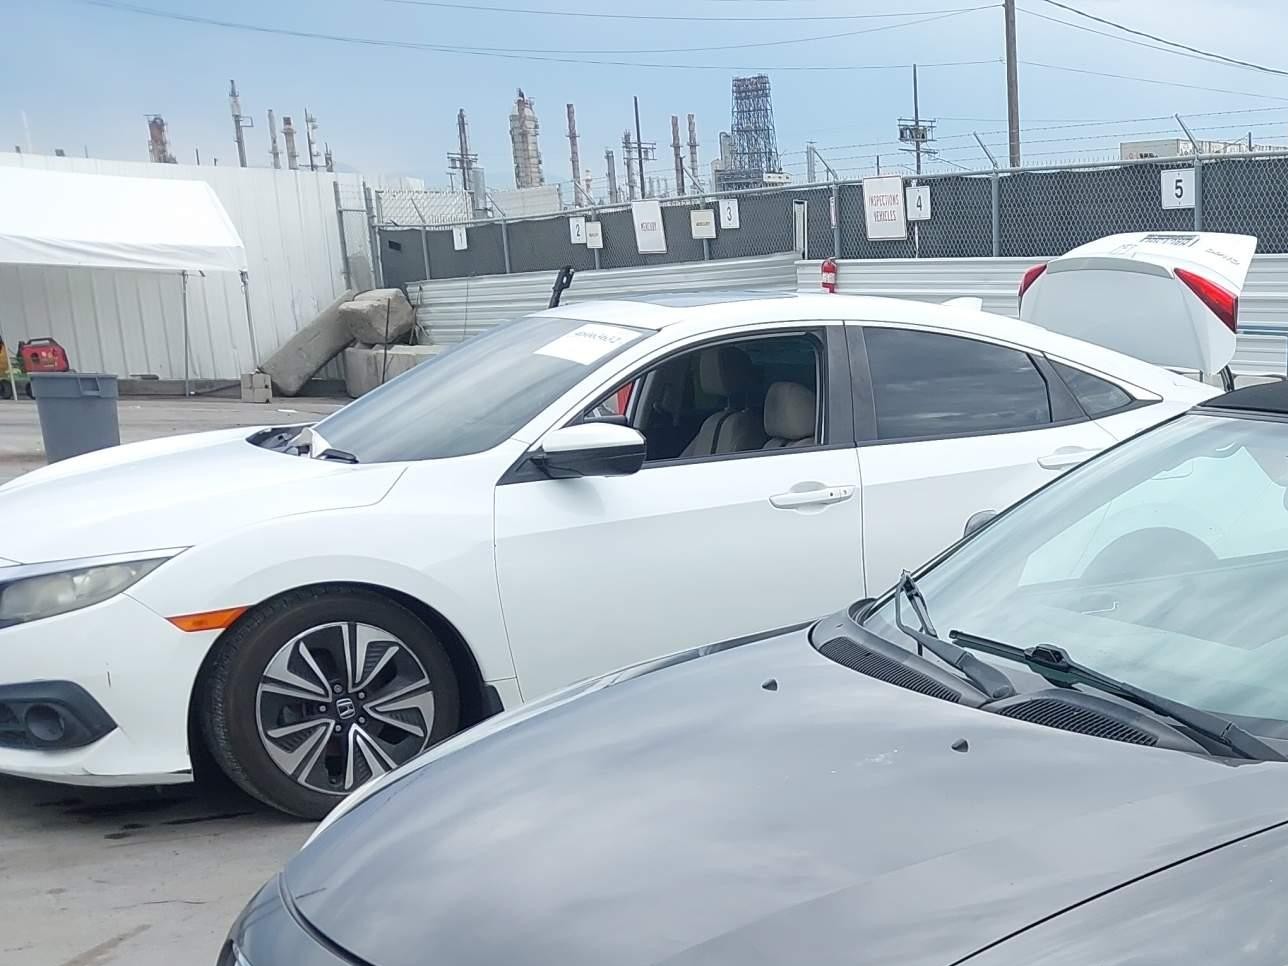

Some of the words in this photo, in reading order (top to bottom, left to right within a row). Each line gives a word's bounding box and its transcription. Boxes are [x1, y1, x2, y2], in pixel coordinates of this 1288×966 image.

[1175, 179, 1184, 199] 5
[868, 193, 899, 207] INSPECTIONS
[916, 195, 923, 211] 4
[727, 206, 733, 222] 3
[874, 210, 897, 223] VEHICLES
[575, 224, 581, 237] 2
